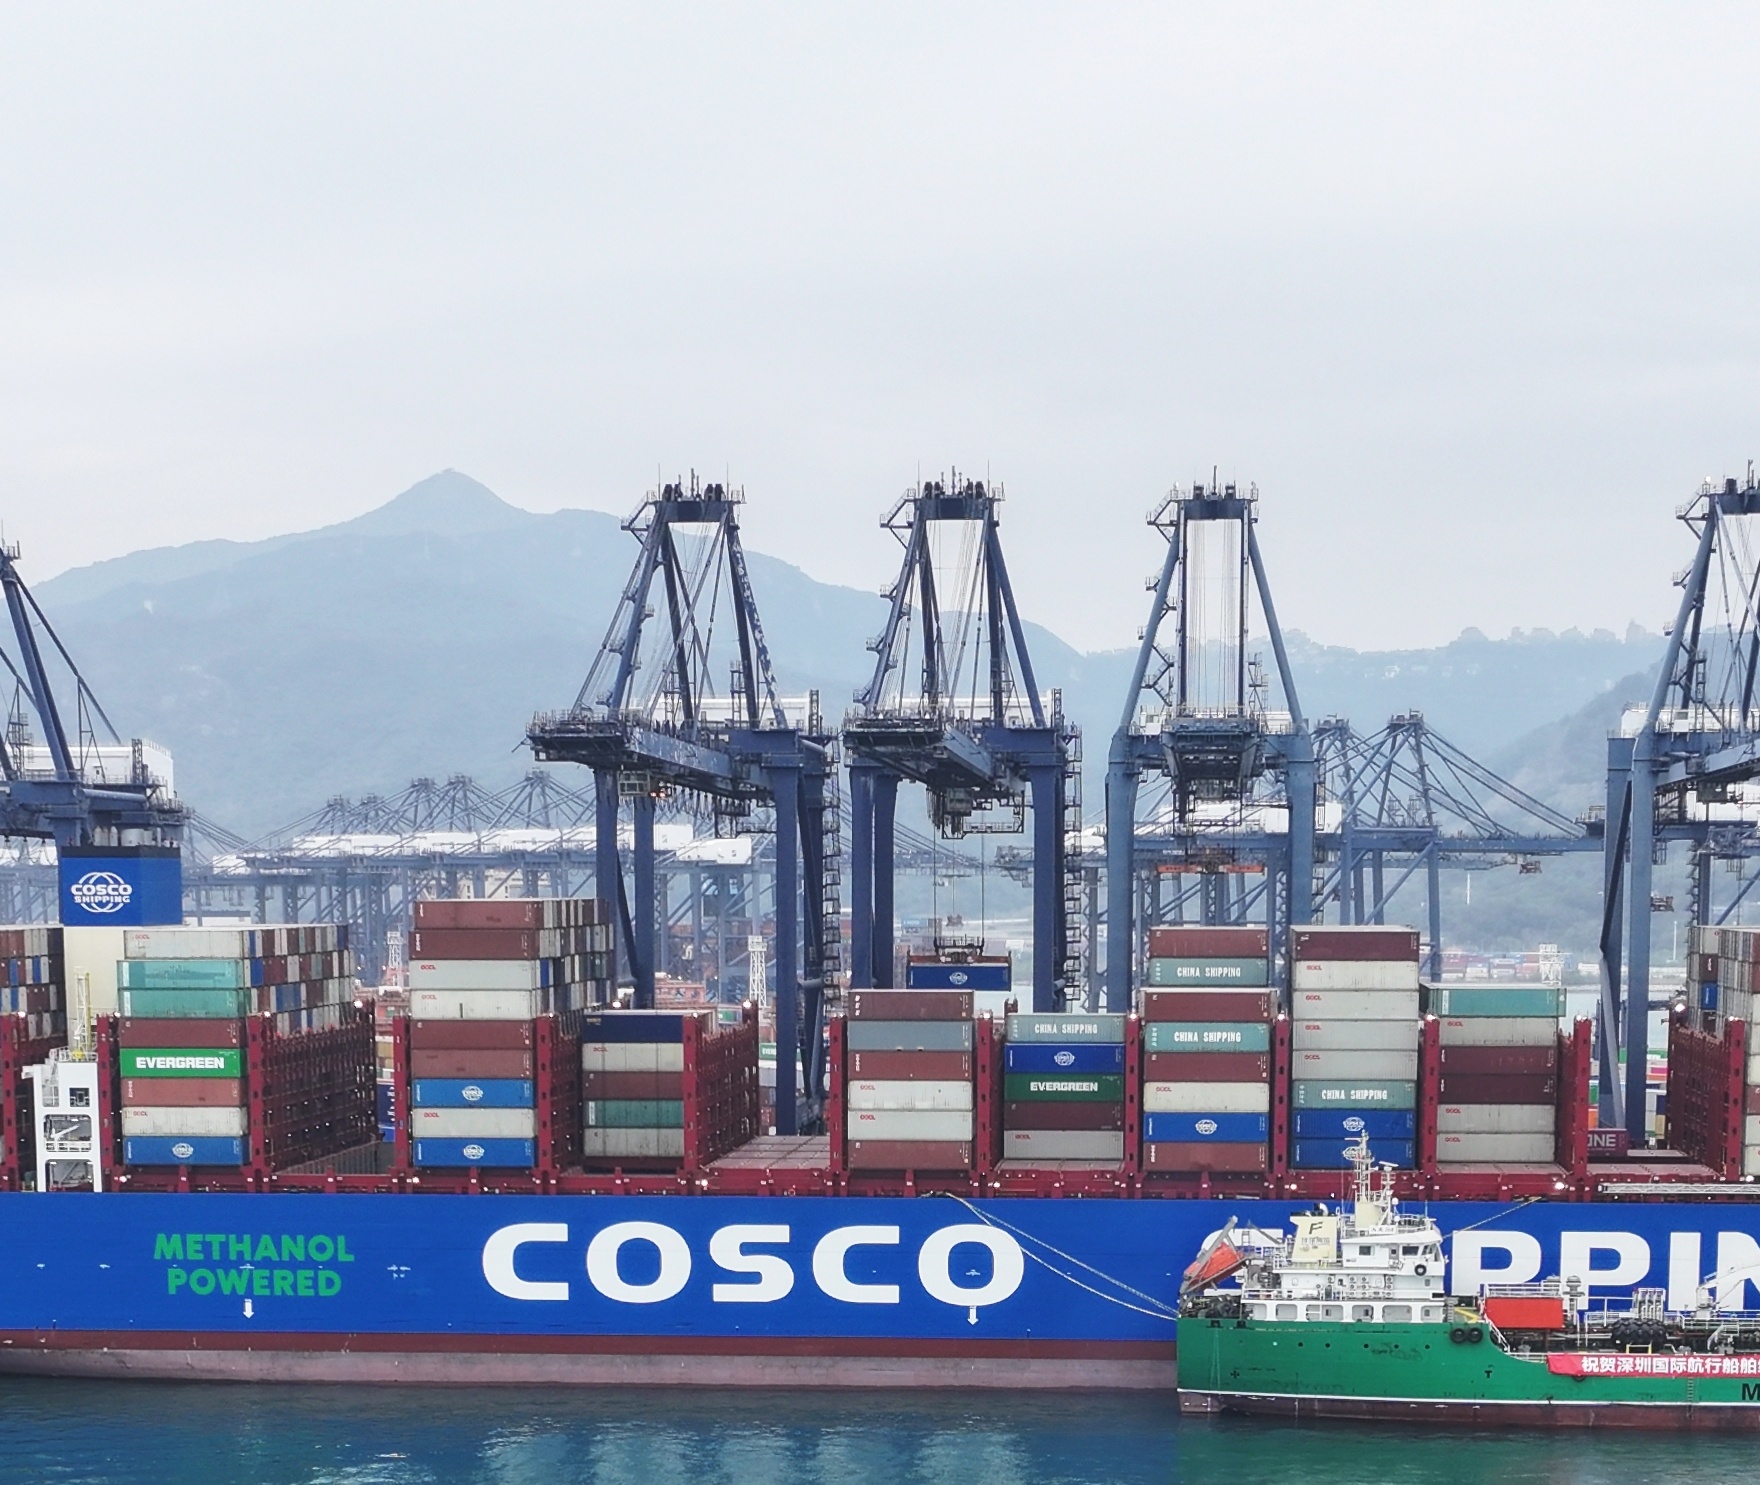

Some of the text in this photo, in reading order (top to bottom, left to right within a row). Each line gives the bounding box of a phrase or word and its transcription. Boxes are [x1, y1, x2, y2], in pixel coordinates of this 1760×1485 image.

[71, 884, 133, 896] COSCO
[74, 895, 131, 903] SHIPPING
[1177, 967, 1241, 977] CHINA SHIPPING
[1035, 1024, 1098, 1034] CHINA SHIPPING
[1174, 1032, 1242, 1042] CHINA SHIPPING
[136, 1057, 225, 1069] EVERGREEN
[1030, 1082, 1099, 1091] EVERGREEN
[1321, 1090, 1388, 1100] CHINA SHIPPING
[153, 1233, 355, 1262] METHANOL
[481, 1221, 1025, 1306] COSCO
[167, 1268, 341, 1296] POWERED
